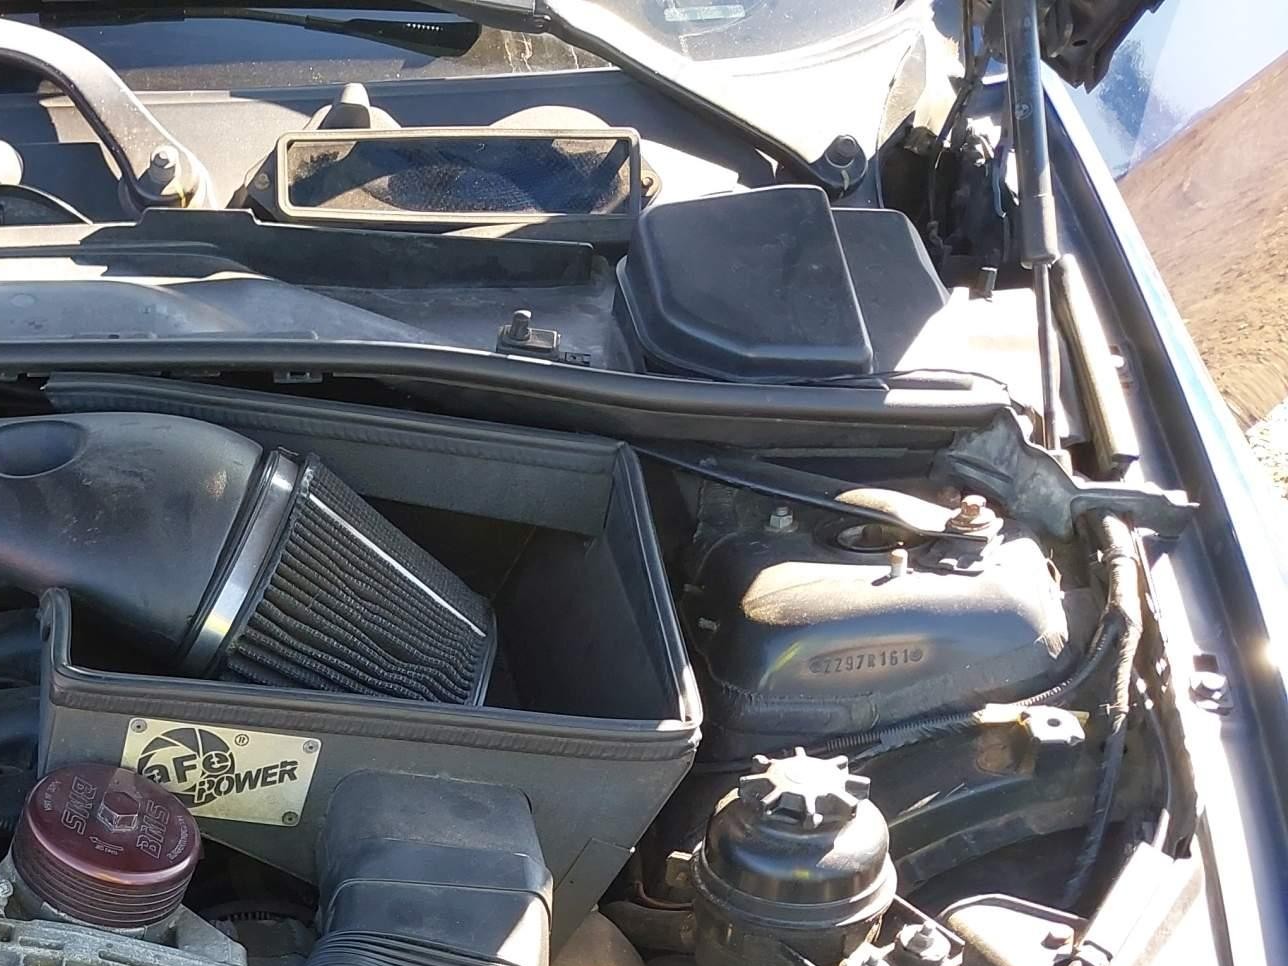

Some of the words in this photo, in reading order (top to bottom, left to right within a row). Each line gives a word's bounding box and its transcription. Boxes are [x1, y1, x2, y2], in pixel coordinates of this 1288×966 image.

[61, 776, 98, 836] BMS
[195, 759, 299, 803] POWER
[136, 800, 171, 859] BMS
